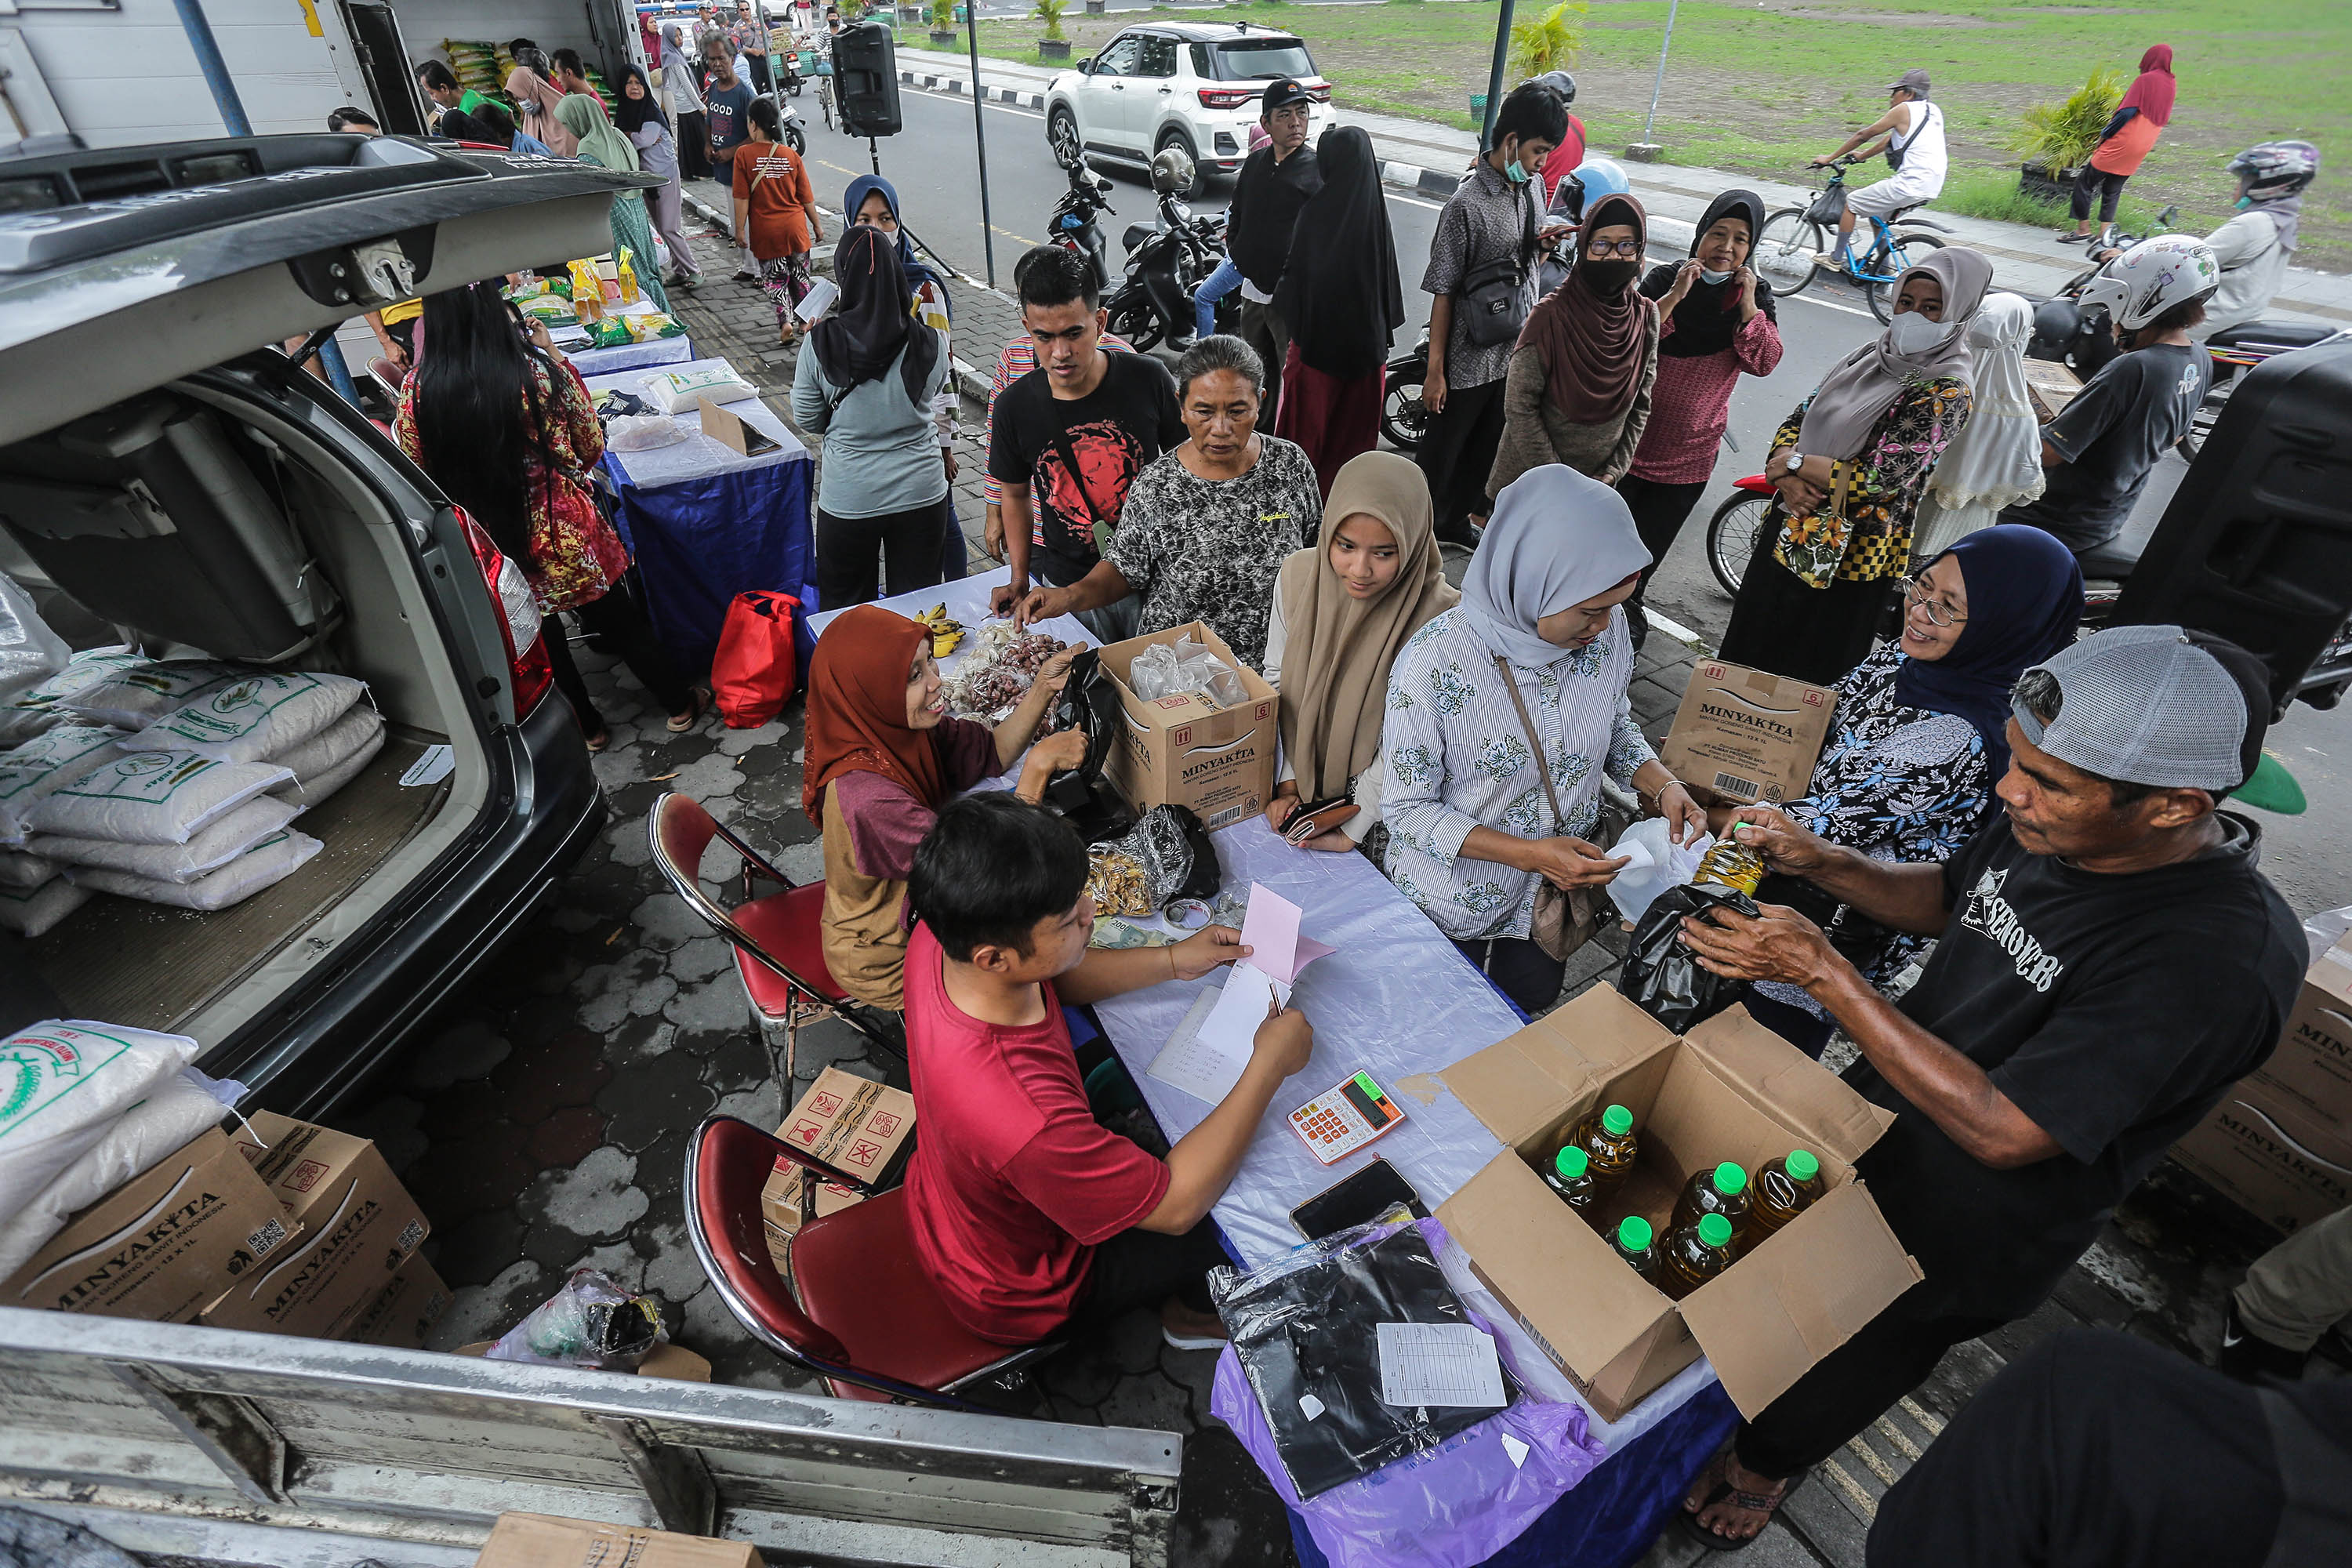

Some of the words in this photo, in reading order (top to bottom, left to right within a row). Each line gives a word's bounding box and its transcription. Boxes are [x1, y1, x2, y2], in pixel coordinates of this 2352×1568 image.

[710, 102, 733, 115] GOOD
[1260, 706, 1266, 715] 6
[1809, 693, 1817, 702] 6
[1700, 699, 1796, 738] MINYAKITA
[1716, 726, 1743, 738] Kemasan
[1179, 746, 1255, 779] MINYAKITA
[98, 1260, 145, 1297] GORENG
[143, 1237, 176, 1263] SAWIT
[175, 1200, 227, 1240] INDONESIA
[262, 1196, 379, 1320] MINYAKITA
[104, 1269, 155, 1308] Kemasan
[161, 1254, 175, 1266] 12
[184, 1236, 198, 1249] 1L
